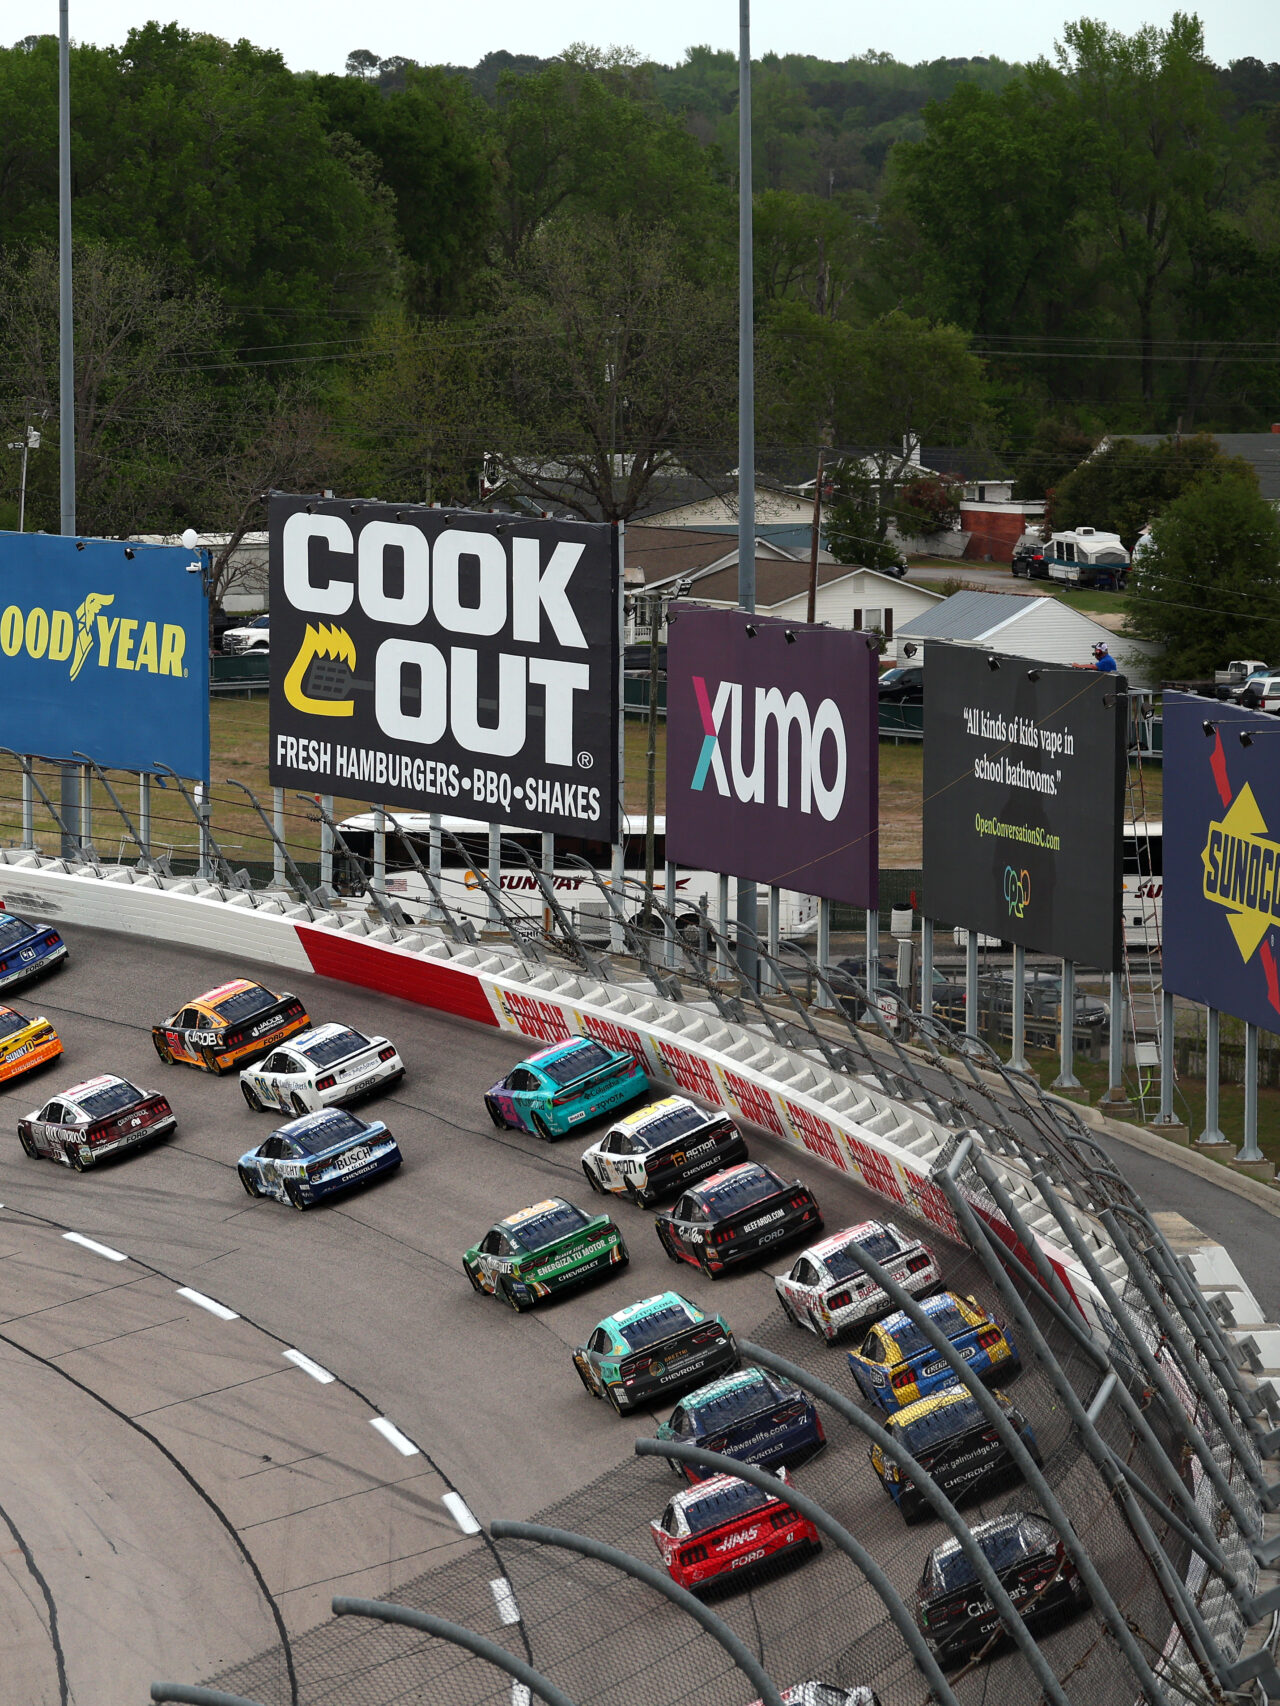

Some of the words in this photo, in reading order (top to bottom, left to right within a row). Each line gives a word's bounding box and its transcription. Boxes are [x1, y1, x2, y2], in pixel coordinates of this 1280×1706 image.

[283, 512, 589, 649] COOK
[375, 638, 590, 767] OUT
[981, 710, 1006, 742] kinds
[1009, 716, 1018, 744] of
[1020, 716, 1039, 748] kids
[1040, 730, 1062, 758] vape
[1064, 726, 1074, 756] in
[277, 734, 330, 774] FRESH
[975, 753, 1004, 784] school
[975, 813, 1060, 850] OpenConversationSC.com
[499, 875, 587, 890] SUNAY
[25, 960, 44, 974] FORD
[258, 1014, 283, 1028] JACOB
[166, 1031, 184, 1056] 51
[189, 1032, 218, 1046] JACOB
[263, 1031, 284, 1046] FORD
[11, 1055, 44, 1074] CHEVROLET
[254, 1076, 275, 1102] 38
[354, 1078, 376, 1092] FORD
[590, 1078, 620, 1098] Columbia
[596, 1092, 624, 1112] TOYOTA
[126, 1130, 148, 1144] FORD
[730, 1130, 738, 1140] 16
[686, 1138, 716, 1158] ACTION
[336, 1148, 371, 1171] BUSCH
[346, 1160, 368, 1172] LIGHT
[594, 1154, 612, 1182] 16
[683, 1156, 722, 1178] CHEVROLET
[341, 1161, 379, 1182] CHEVROLET
[802, 1211, 809, 1220] 4
[758, 1229, 784, 1246] FORD
[537, 1257, 572, 1276] ENERGIZA
[573, 1252, 582, 1262] TU
[582, 1240, 607, 1257] MOTOR
[558, 1260, 599, 1282] CHEVROLET
[716, 1337, 726, 1345] 3
[660, 1361, 705, 1384] CHEVROLET
[798, 1414, 807, 1426] 71
[934, 1463, 950, 1476] visit
[950, 1440, 1000, 1468] gainbridge.io
[944, 1460, 996, 1488] CHEVROLET
[719, 1527, 758, 1552] HAAS
[786, 1532, 794, 1543] 41
[732, 1549, 765, 1568] FORD
